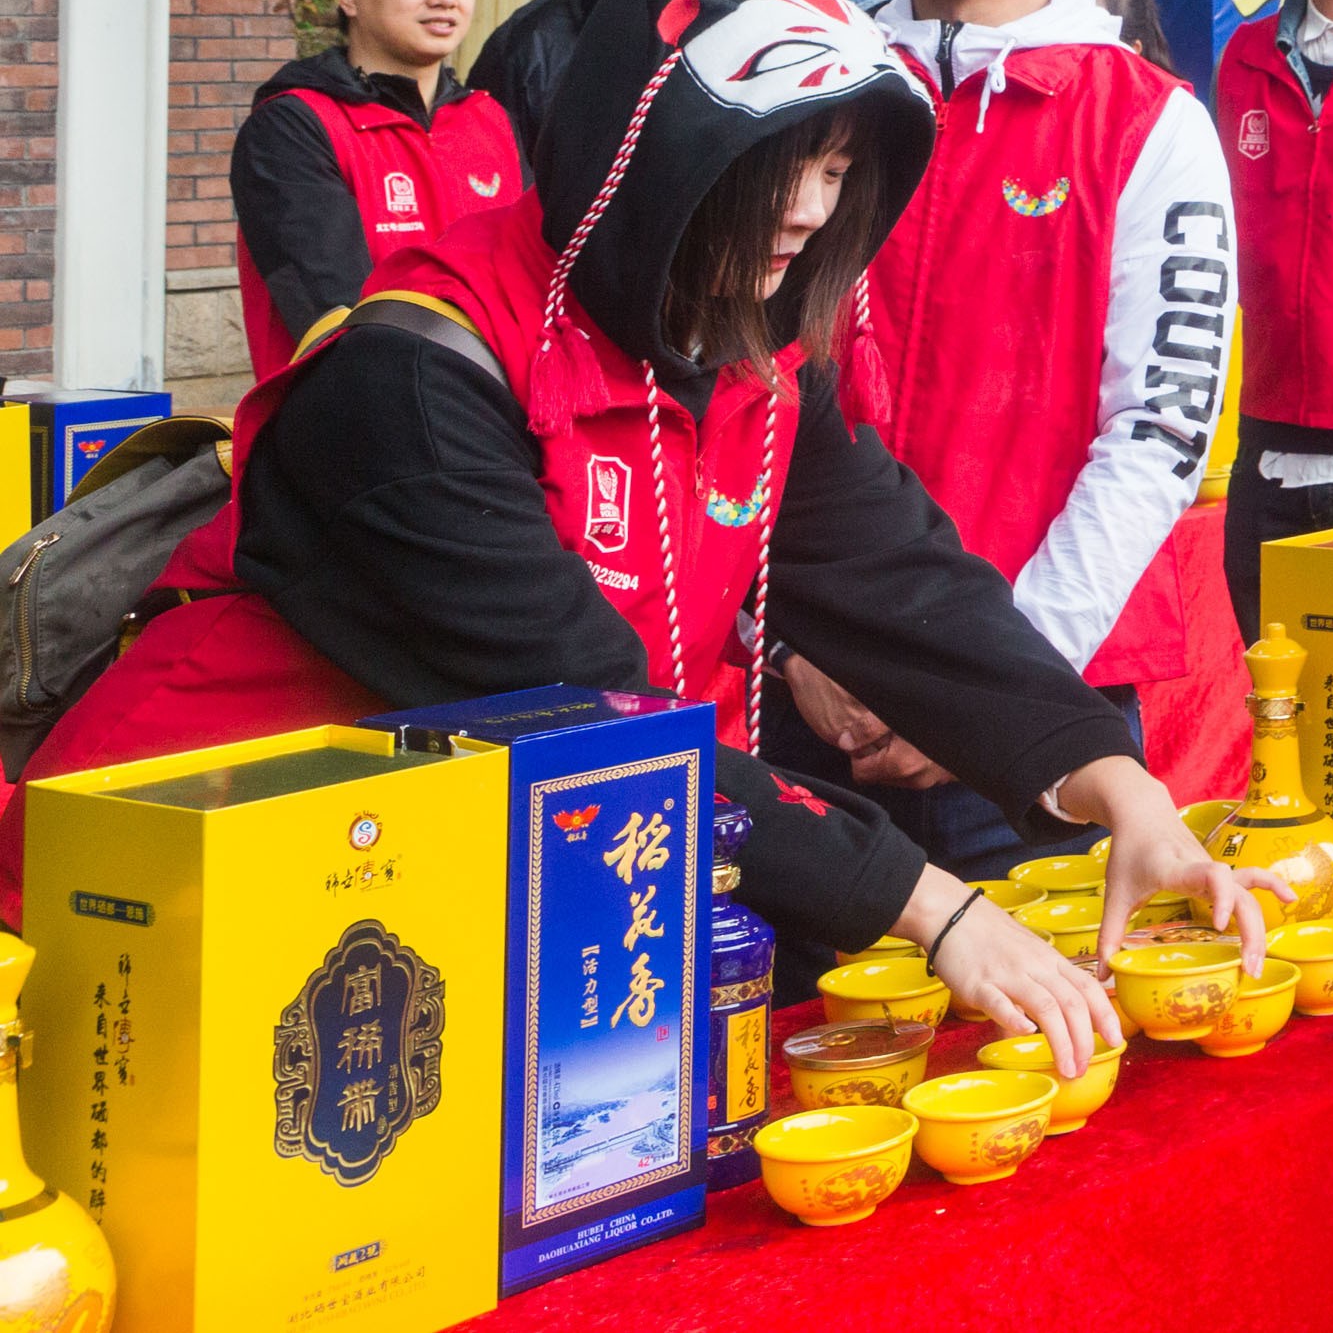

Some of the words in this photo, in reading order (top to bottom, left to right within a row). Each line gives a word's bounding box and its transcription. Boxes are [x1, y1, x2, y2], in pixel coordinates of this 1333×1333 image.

[604, 812, 671, 1028] 稻花香
[732, 1017, 763, 1108] 稻花香
[538, 1234, 601, 1263] DAOHUAXIANG
[605, 1221, 638, 1239] LIQUOR
[577, 1223, 605, 1239] HUBEI
[609, 1213, 637, 1229] CHINA
